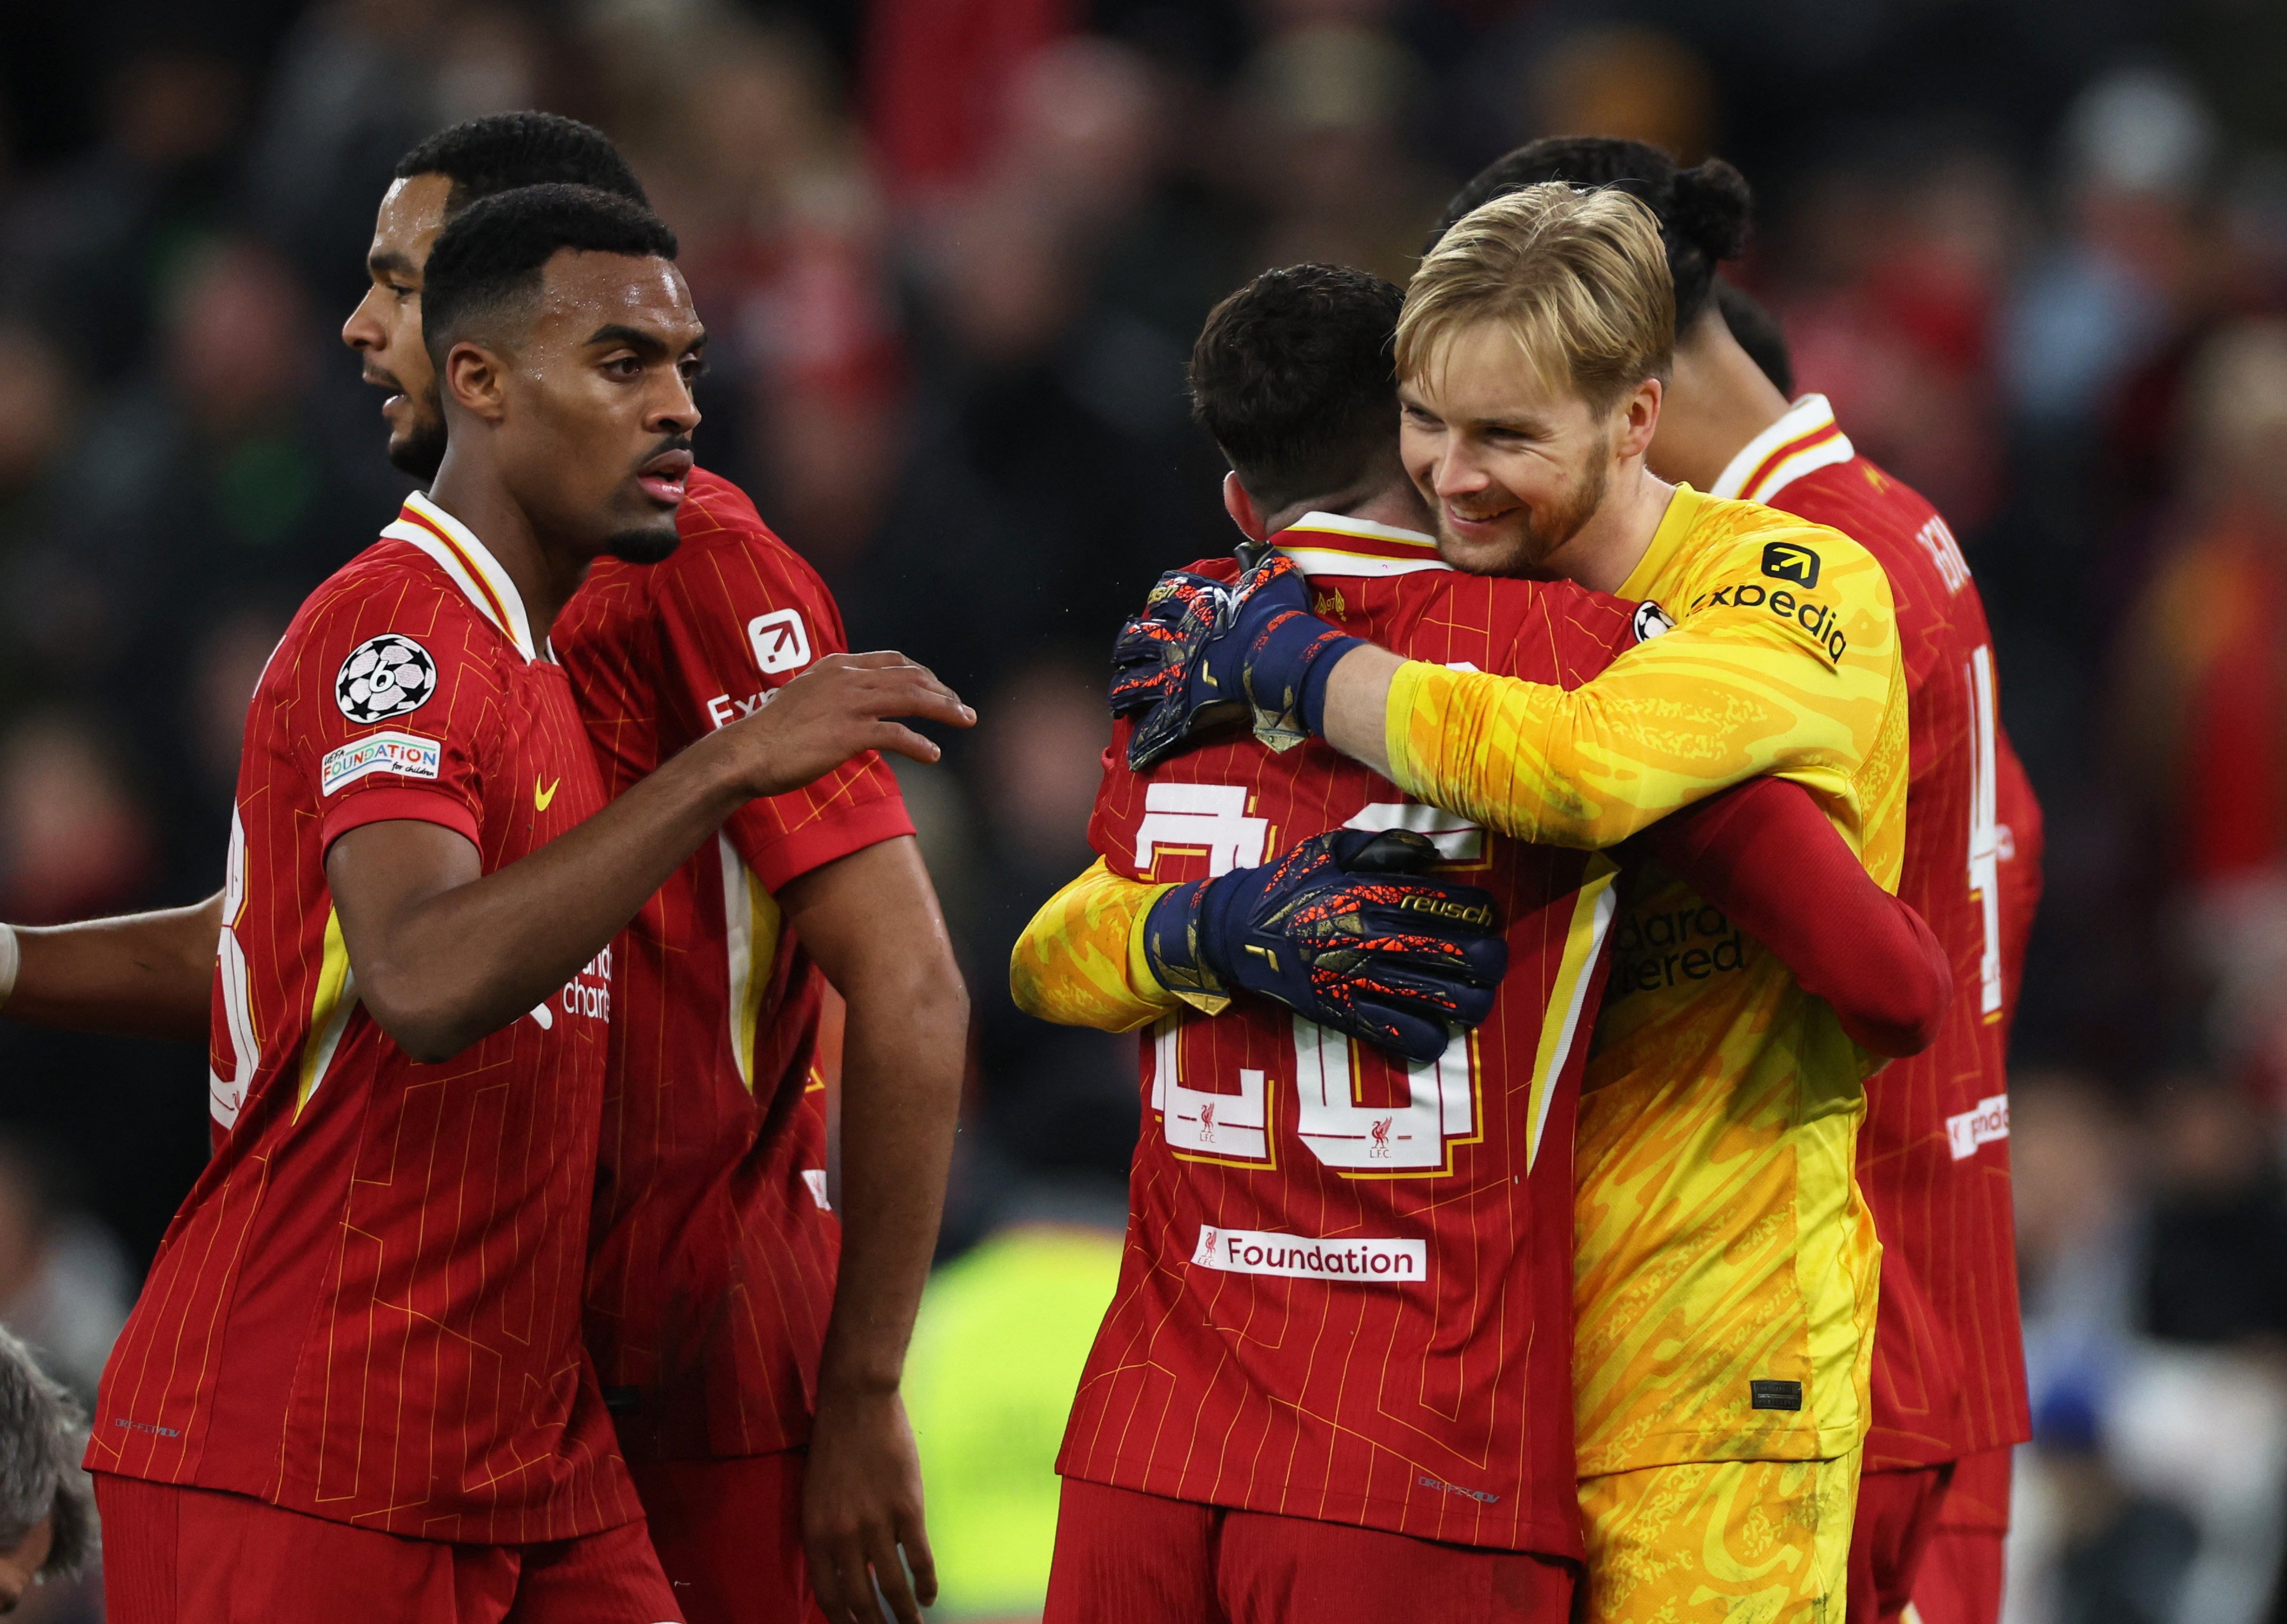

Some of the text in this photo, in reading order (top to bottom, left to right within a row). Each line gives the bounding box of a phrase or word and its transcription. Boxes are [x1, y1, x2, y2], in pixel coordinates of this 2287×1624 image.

[1326, 598, 1335, 611] 97
[1686, 584, 1847, 664] xpedia
[368, 660, 395, 693] 6
[324, 749, 345, 766] UEFA
[324, 744, 436, 781] FOUNDATION
[391, 761, 435, 778] for children
[1400, 894, 1494, 927] reusch
[1227, 1237, 1414, 1274] Foundation
